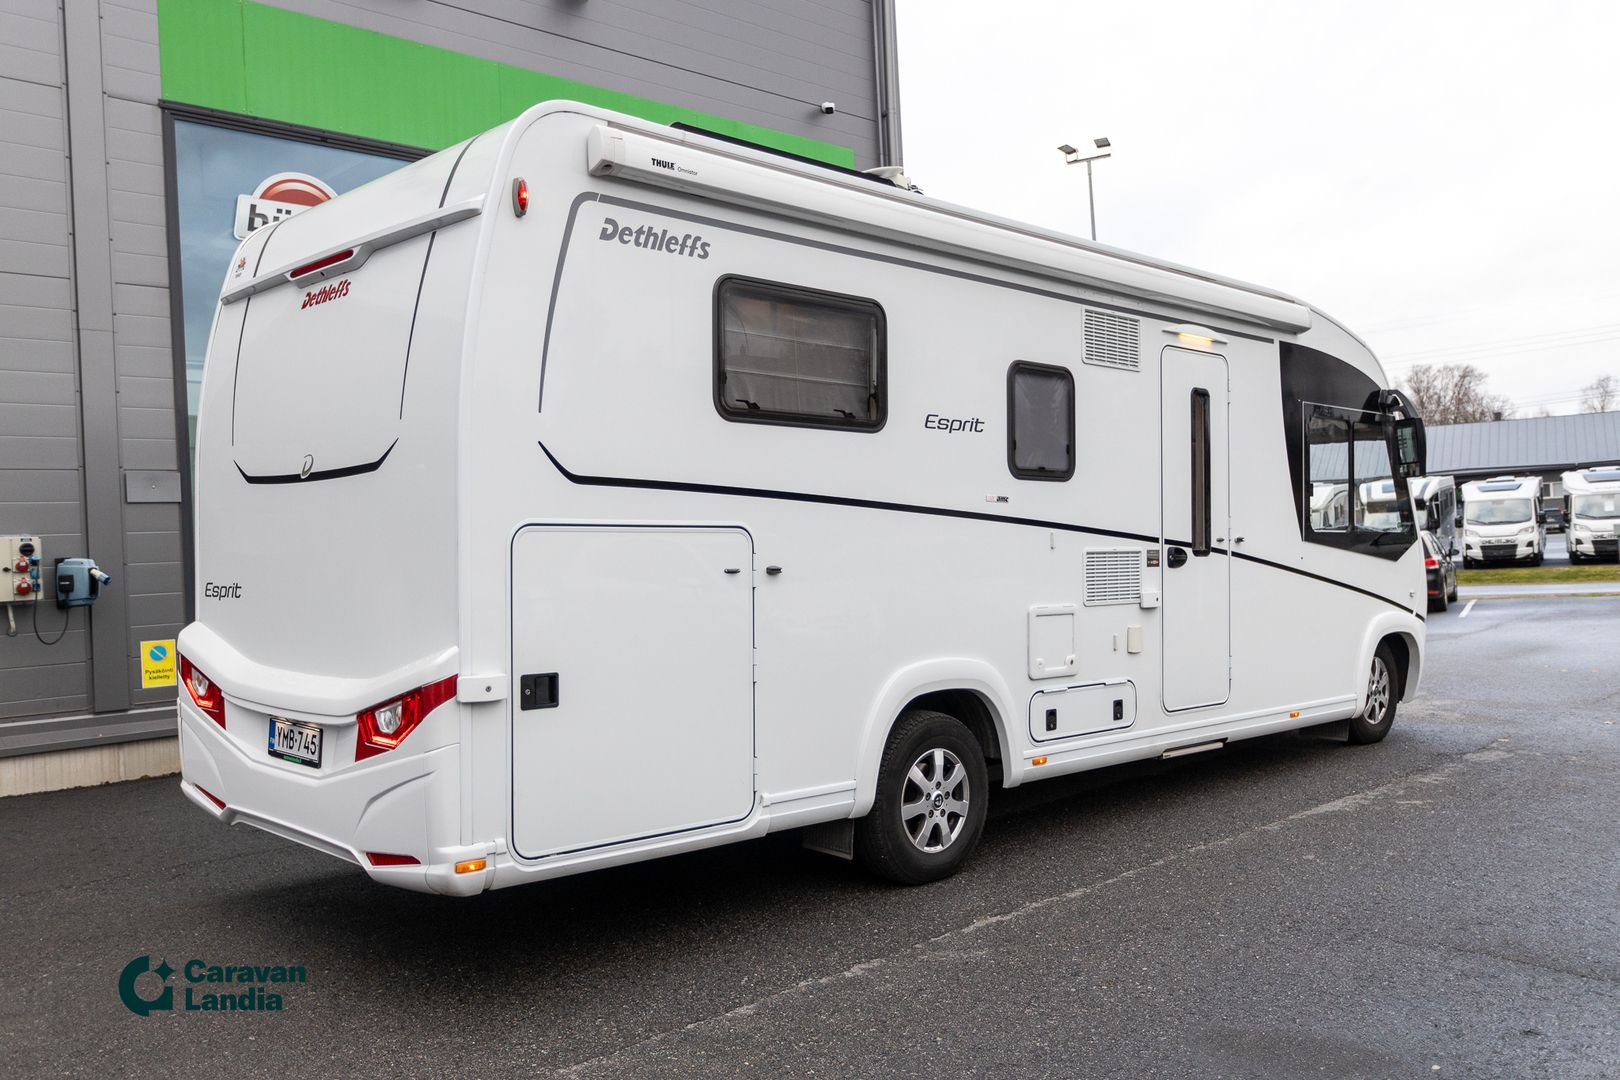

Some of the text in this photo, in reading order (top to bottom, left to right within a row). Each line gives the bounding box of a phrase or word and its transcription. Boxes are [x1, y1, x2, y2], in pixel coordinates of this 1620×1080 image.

[651, 157, 675, 171] THULE
[599, 217, 711, 260] Dethleffs
[301, 279, 352, 310] Dethleffs
[924, 413, 985, 434] Esprit
[204, 582, 242, 601] Esprit
[277, 725, 317, 756] YMB-745
